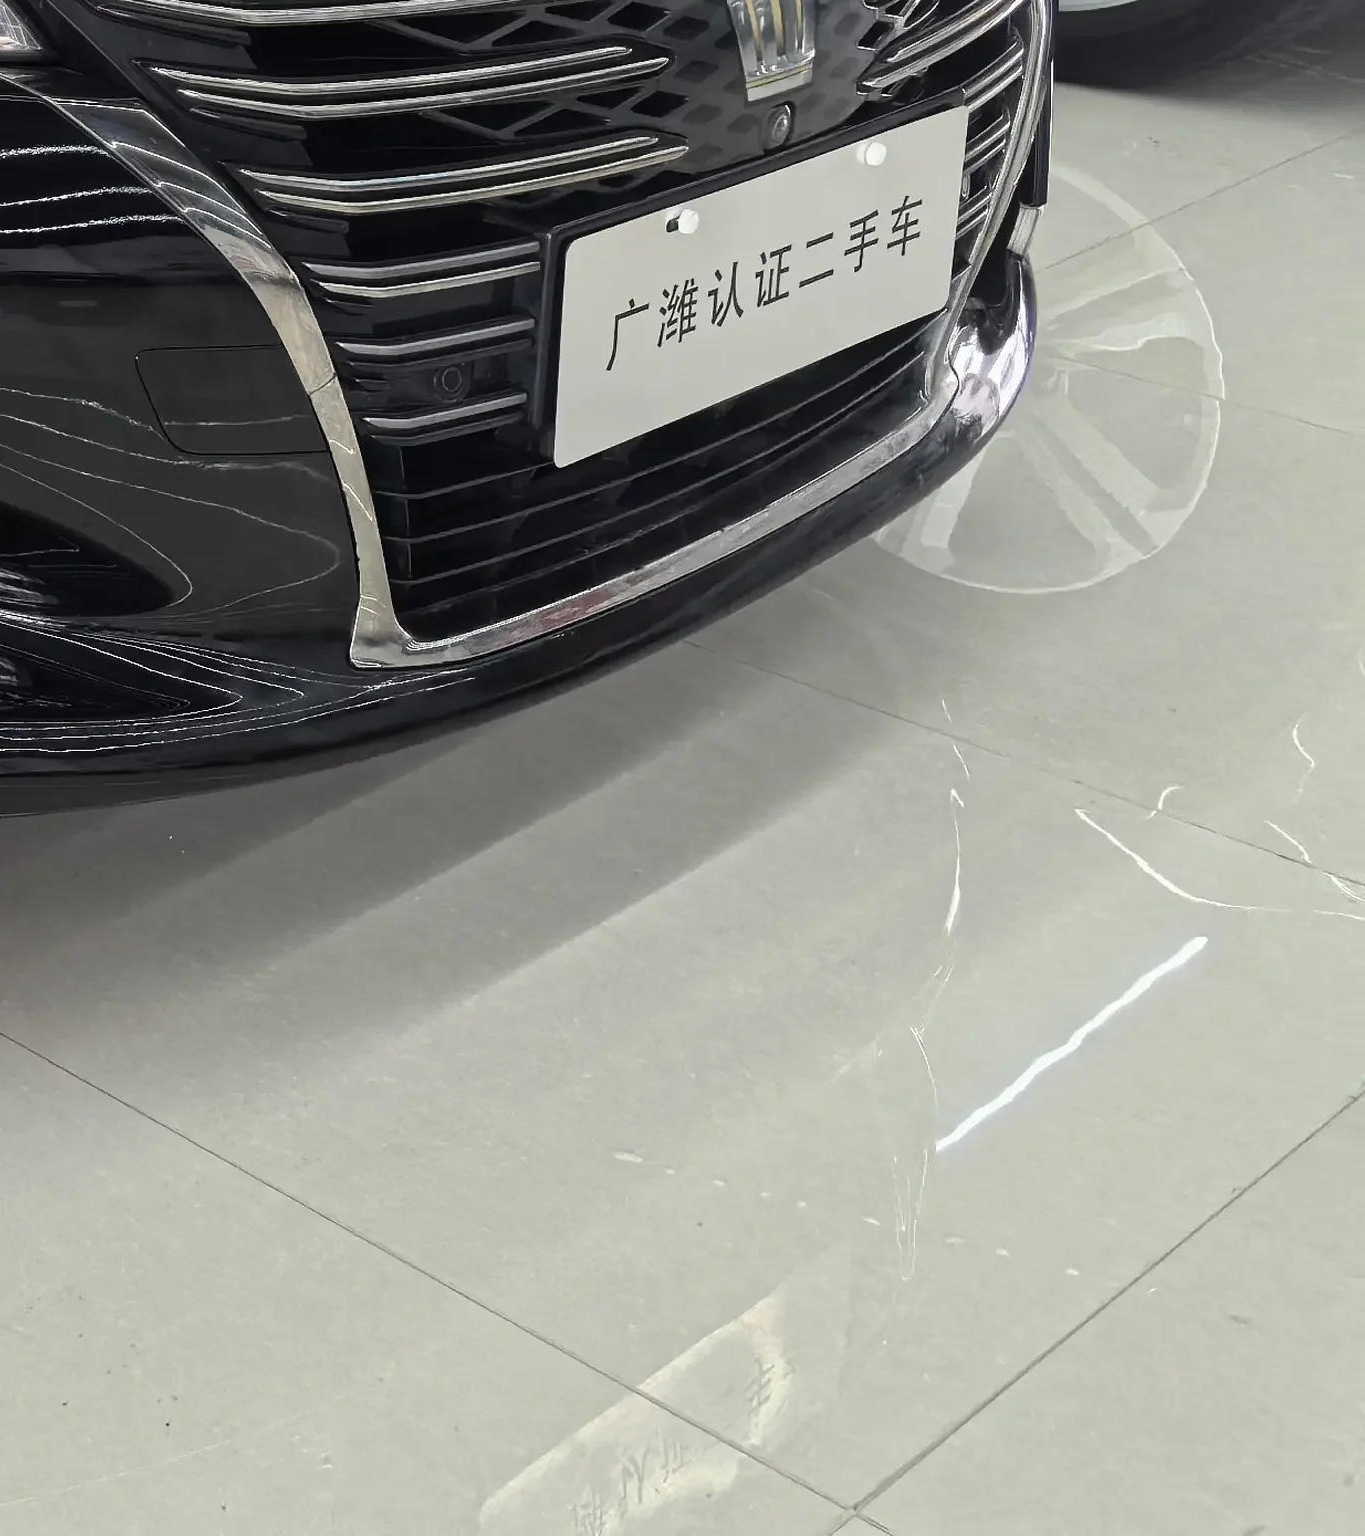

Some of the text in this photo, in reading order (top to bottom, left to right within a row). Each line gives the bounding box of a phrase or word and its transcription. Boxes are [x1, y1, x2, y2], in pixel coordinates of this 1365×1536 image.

[606, 195, 923, 371] 广潍认证二手车
